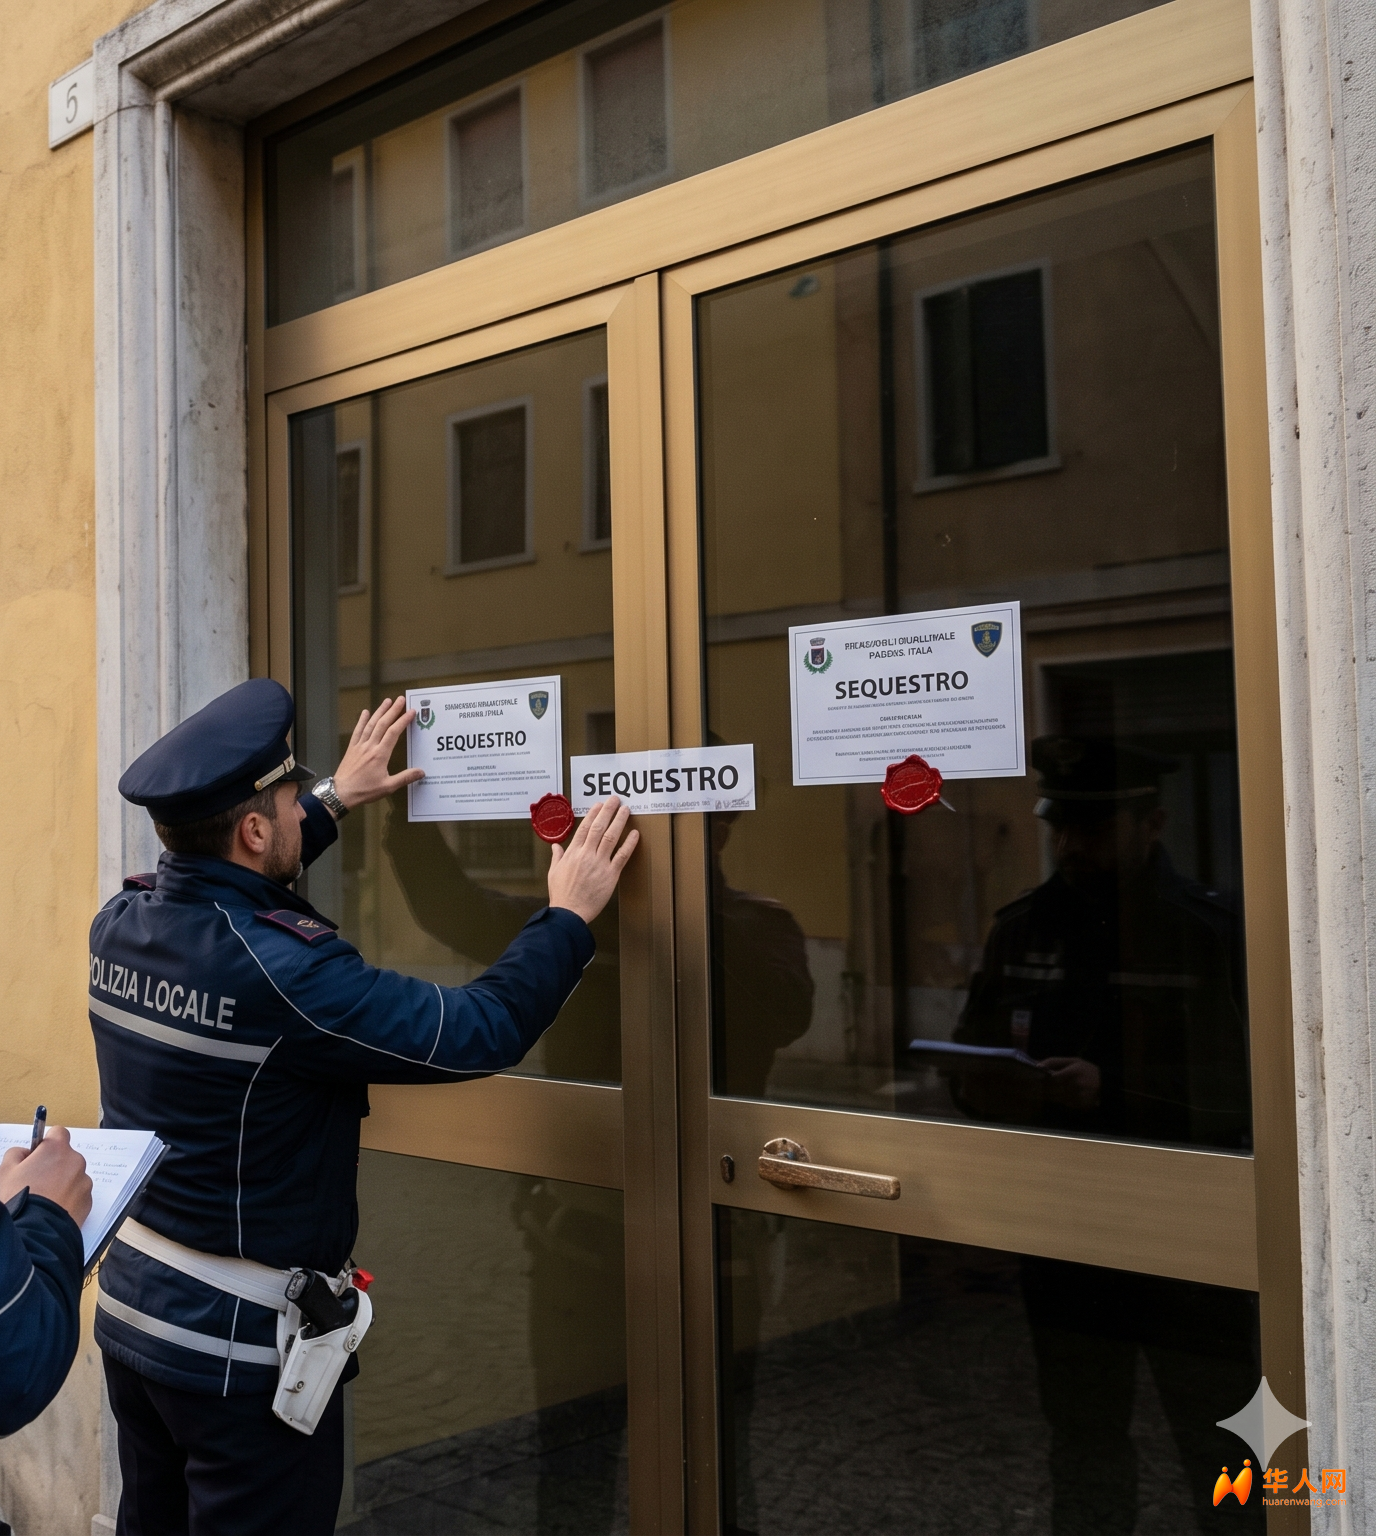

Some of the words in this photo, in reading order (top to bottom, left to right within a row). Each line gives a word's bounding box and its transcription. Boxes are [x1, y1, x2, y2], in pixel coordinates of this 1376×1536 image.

[65, 82, 78, 124] 5
[835, 670, 969, 699] SEQUESTRO
[436, 730, 527, 751] SEQUESTRO
[583, 765, 739, 798] SEQUESTRO
[143, 976, 236, 1031] LOCALE
